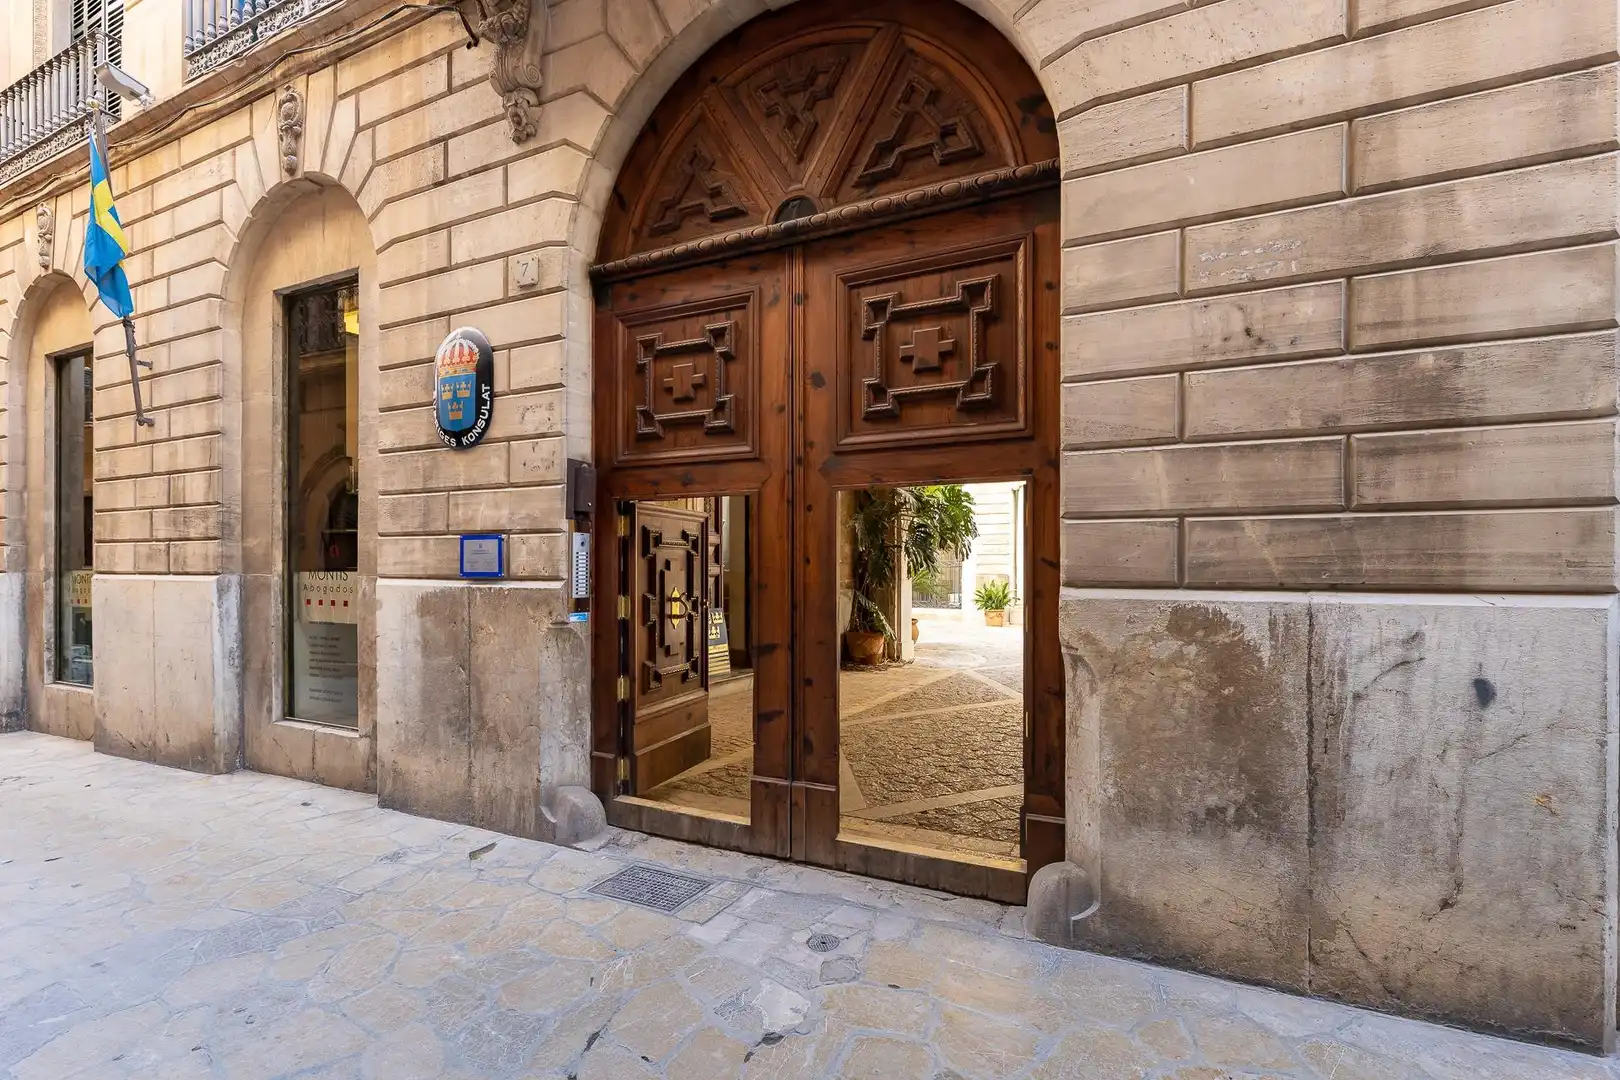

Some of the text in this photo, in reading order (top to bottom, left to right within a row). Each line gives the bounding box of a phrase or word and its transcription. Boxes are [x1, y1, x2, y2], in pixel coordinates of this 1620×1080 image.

[521, 262, 529, 277] 7
[461, 383, 491, 446] KONSULAT
[308, 569, 349, 582] MONTIS
[302, 583, 354, 595] Abogados
